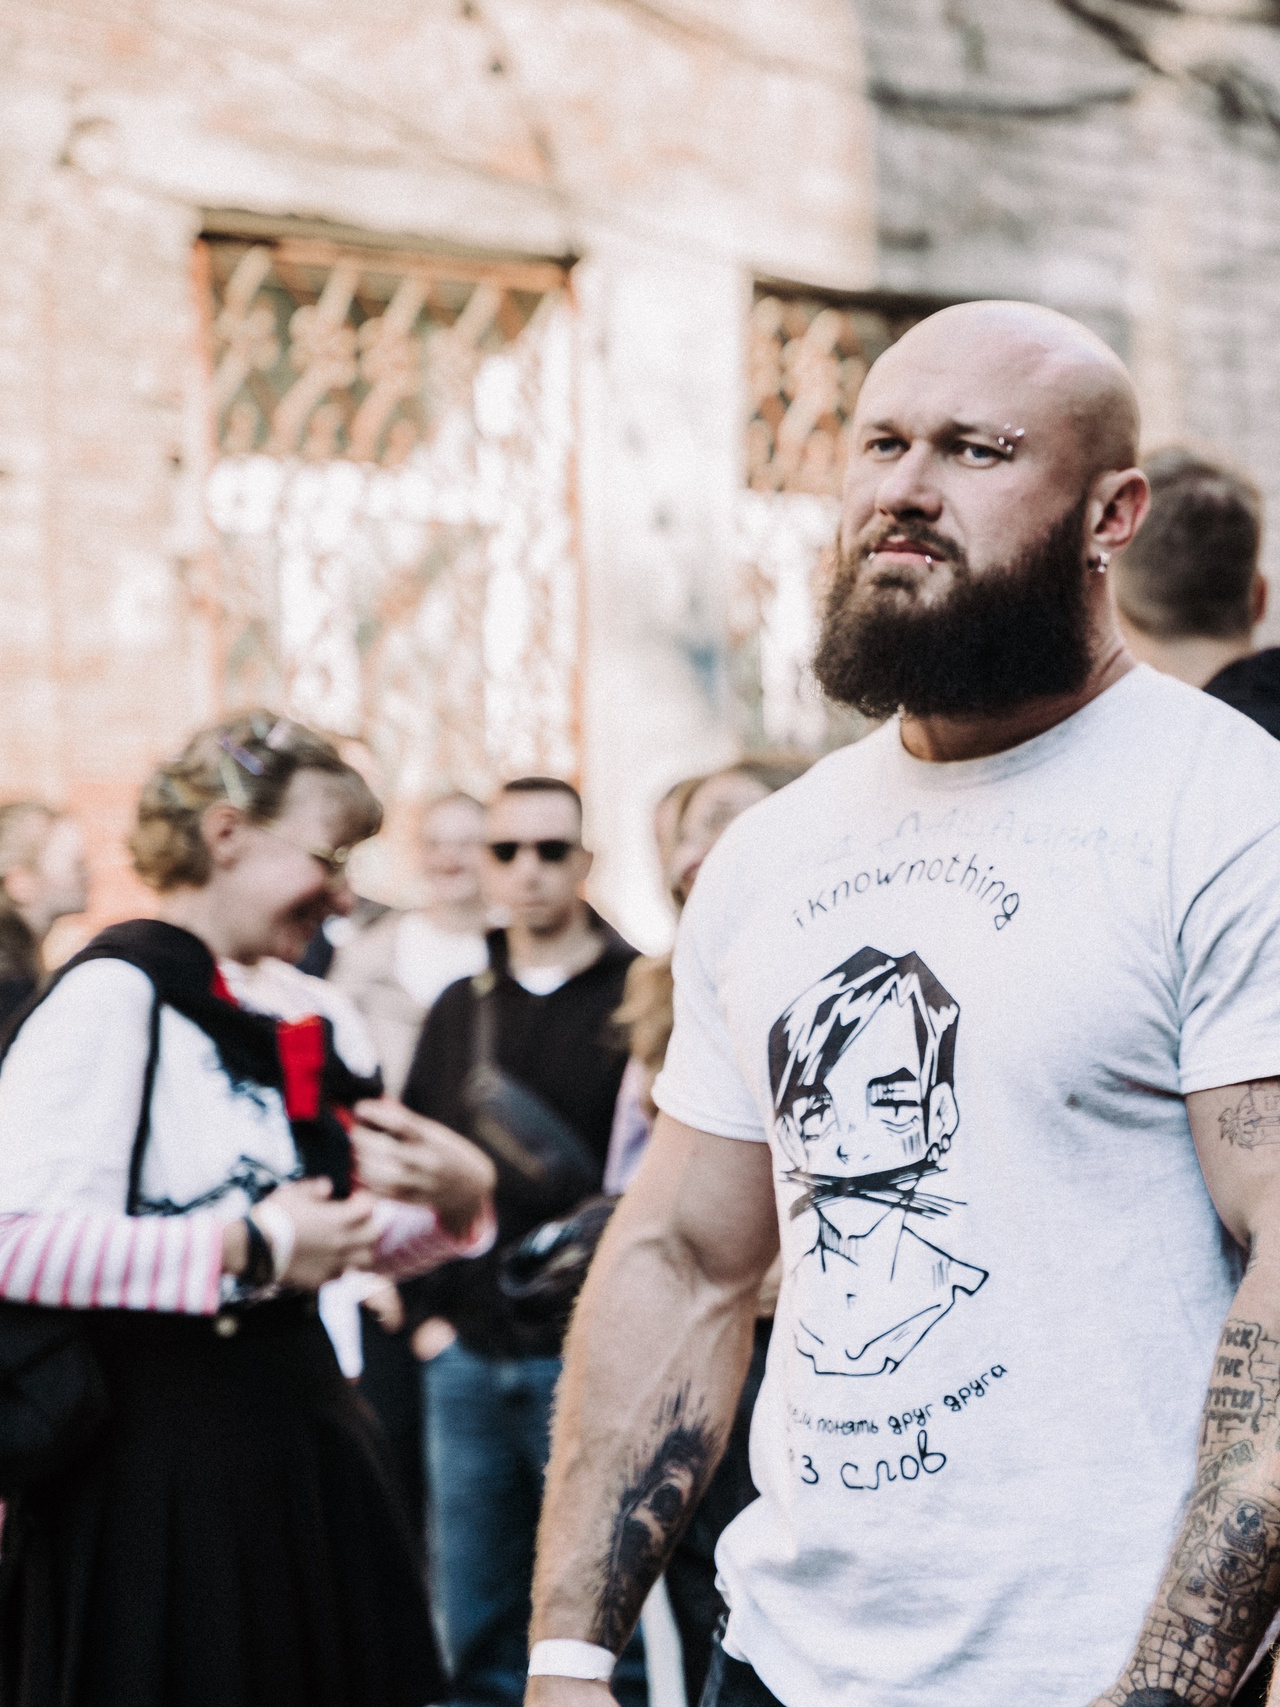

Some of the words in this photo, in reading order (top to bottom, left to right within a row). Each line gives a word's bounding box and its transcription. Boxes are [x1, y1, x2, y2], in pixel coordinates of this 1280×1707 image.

[887, 1404, 933, 1435] друг
[943, 1364, 1008, 1412] друга
[840, 1429, 947, 1490] слов
